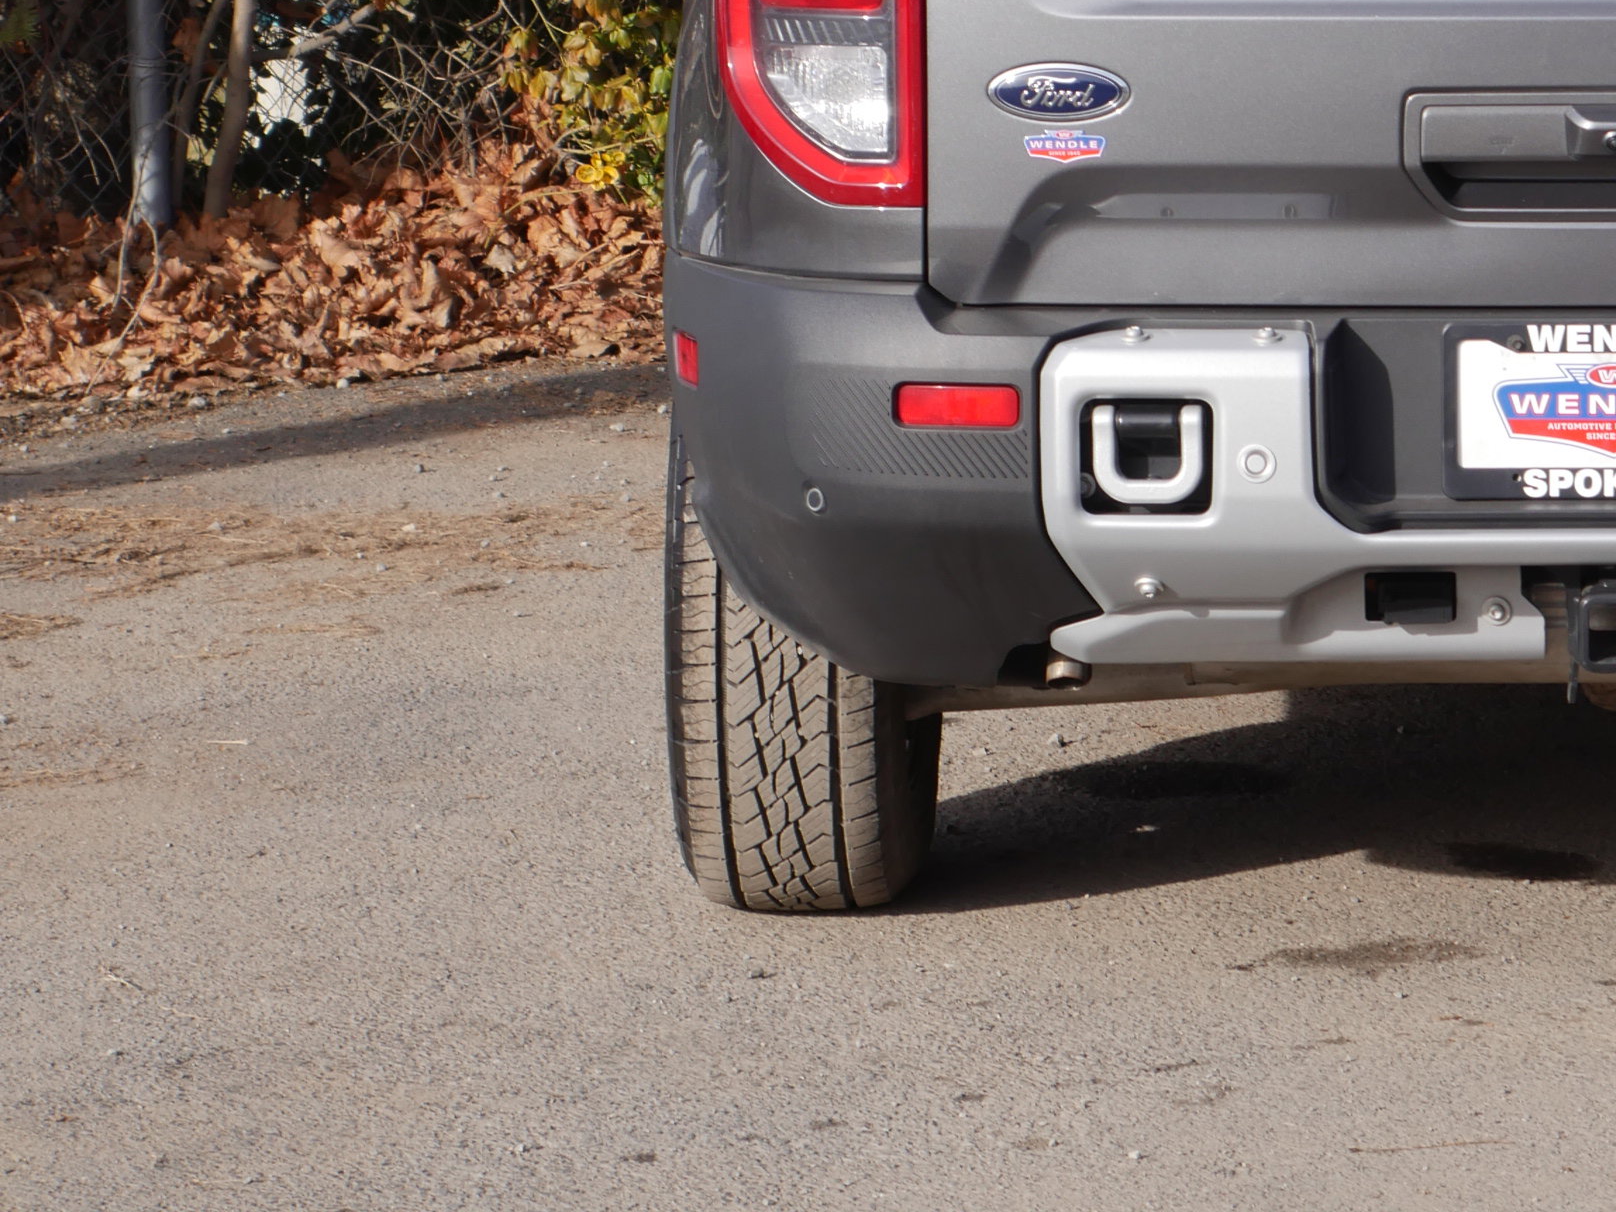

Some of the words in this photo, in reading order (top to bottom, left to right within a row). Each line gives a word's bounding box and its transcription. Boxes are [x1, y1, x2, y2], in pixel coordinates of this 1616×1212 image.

[1020, 75, 1095, 107] Ford
[1029, 140, 1098, 149] WENDLE
[1546, 422, 1613, 431] AUTOMOTIVE
[1586, 432, 1616, 440] SINCE
